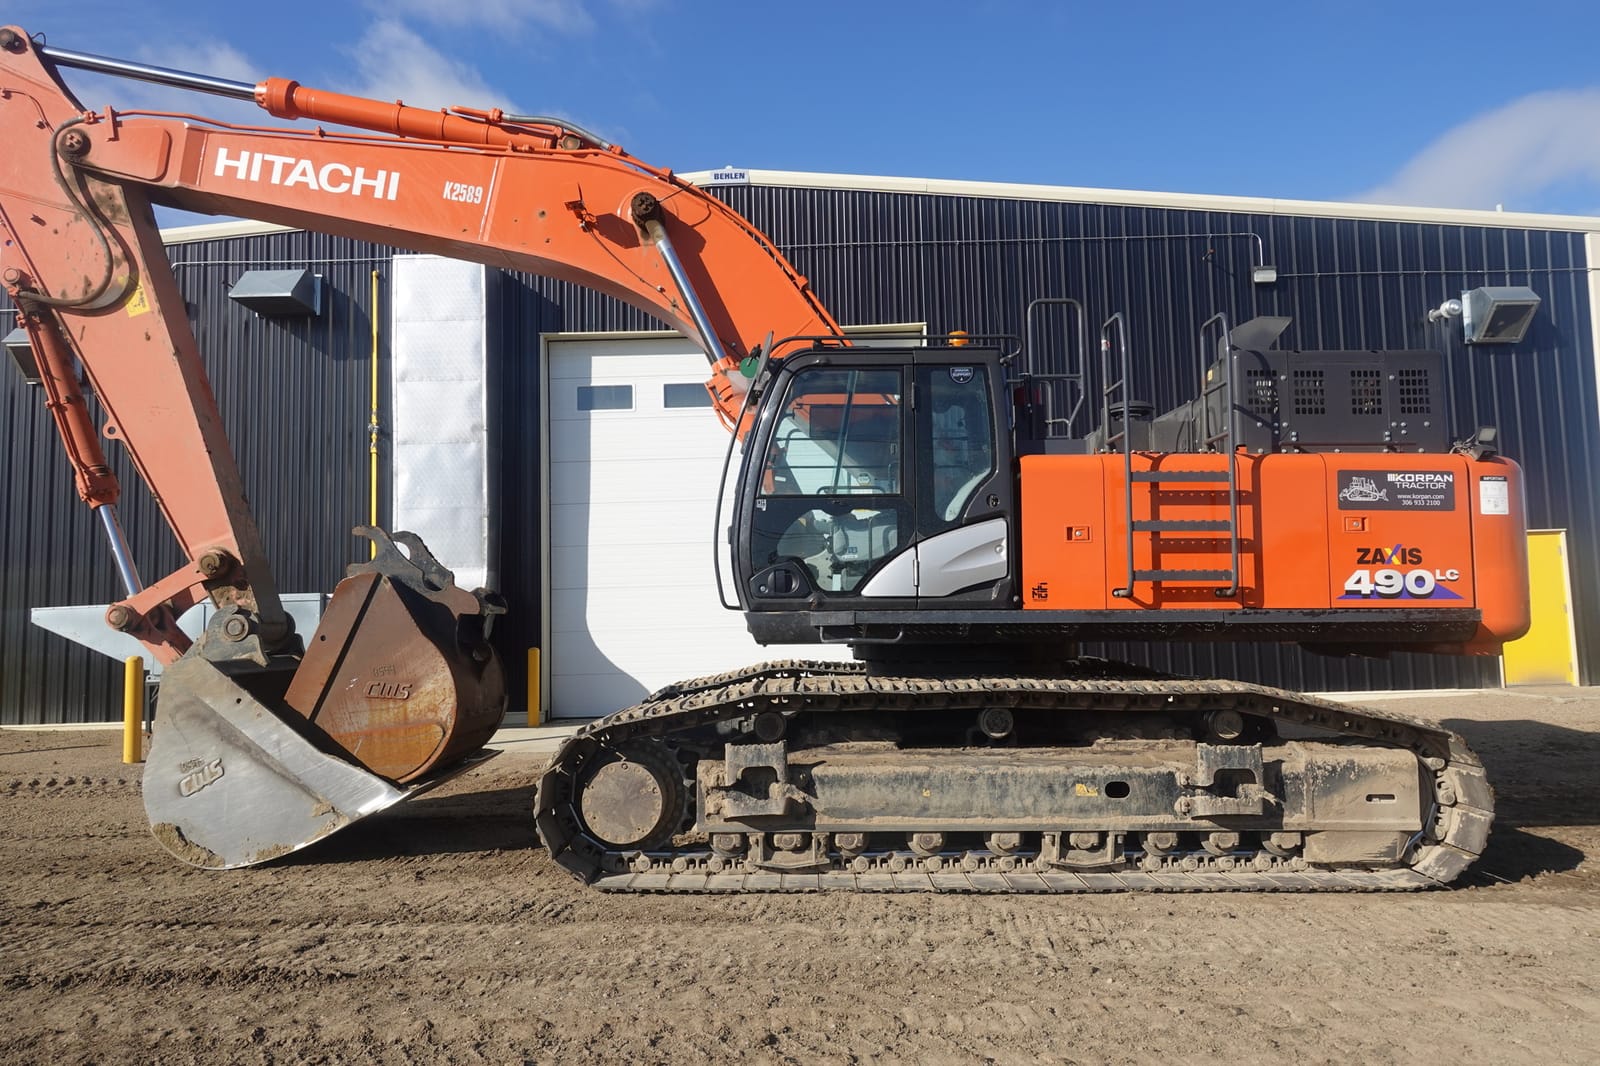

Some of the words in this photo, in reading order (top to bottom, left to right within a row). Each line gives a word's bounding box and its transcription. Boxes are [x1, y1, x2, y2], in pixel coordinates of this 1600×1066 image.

[213, 147, 400, 201] HITACHI
[713, 172, 745, 180] BEHLEN
[442, 180, 483, 205] K2589
[1394, 474, 1453, 482] KORPAN
[1356, 543, 1423, 565] ZAXIS
[1344, 569, 1436, 599] 490
[1435, 569, 1460, 581] LC
